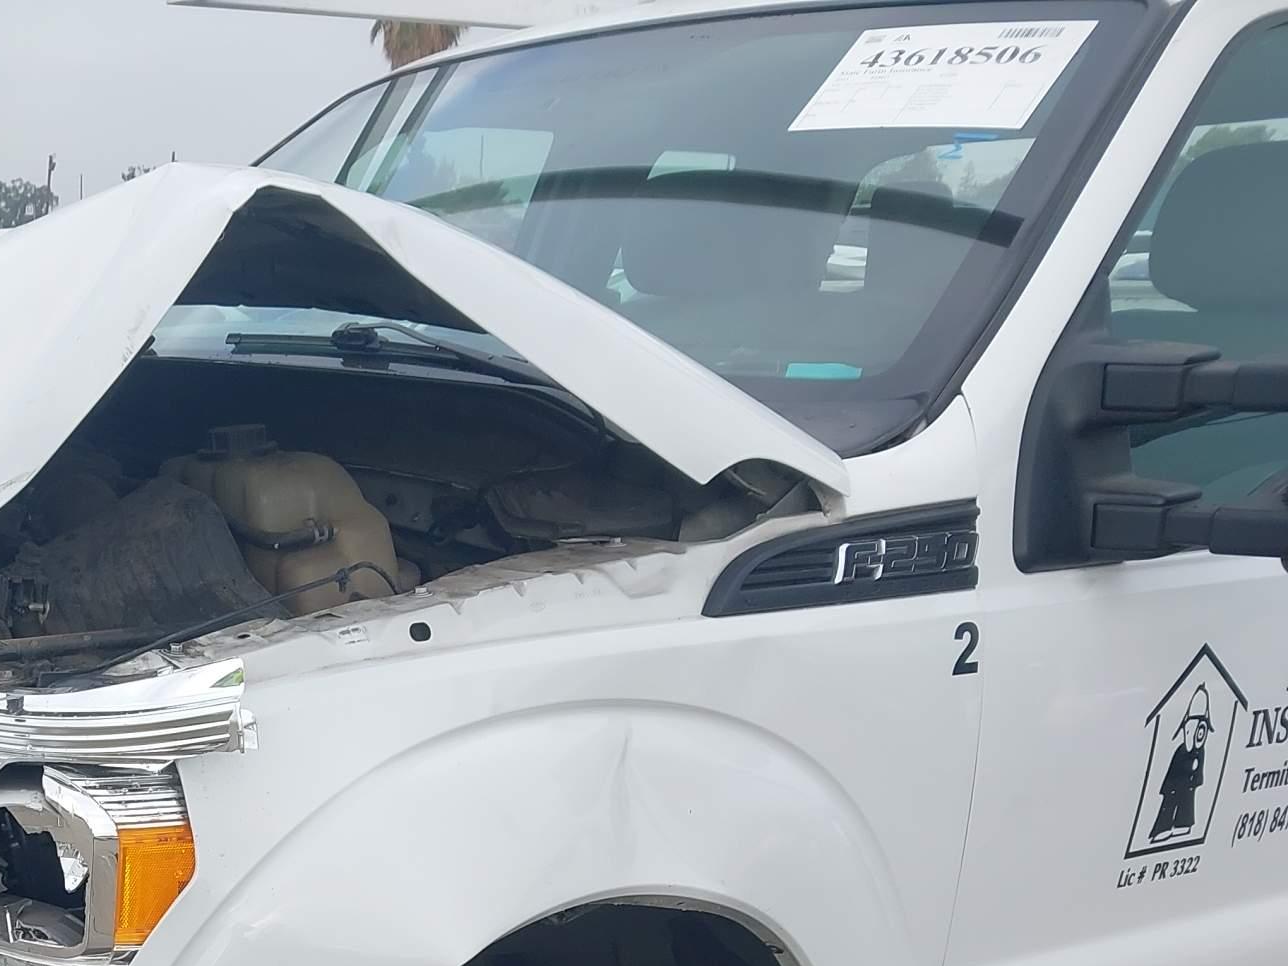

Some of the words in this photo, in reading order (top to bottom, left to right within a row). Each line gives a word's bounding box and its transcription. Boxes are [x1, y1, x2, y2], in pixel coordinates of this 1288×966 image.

[860, 45, 1044, 67] 43618506
[951, 621, 980, 676] 2
[1231, 808, 1269, 849] (818)
[1269, 803, 1288, 833] 84
[1116, 868, 1136, 888] Lic
[1137, 866, 1148, 884] #
[1151, 861, 1169, 881] PR
[1169, 855, 1200, 878] 3322
